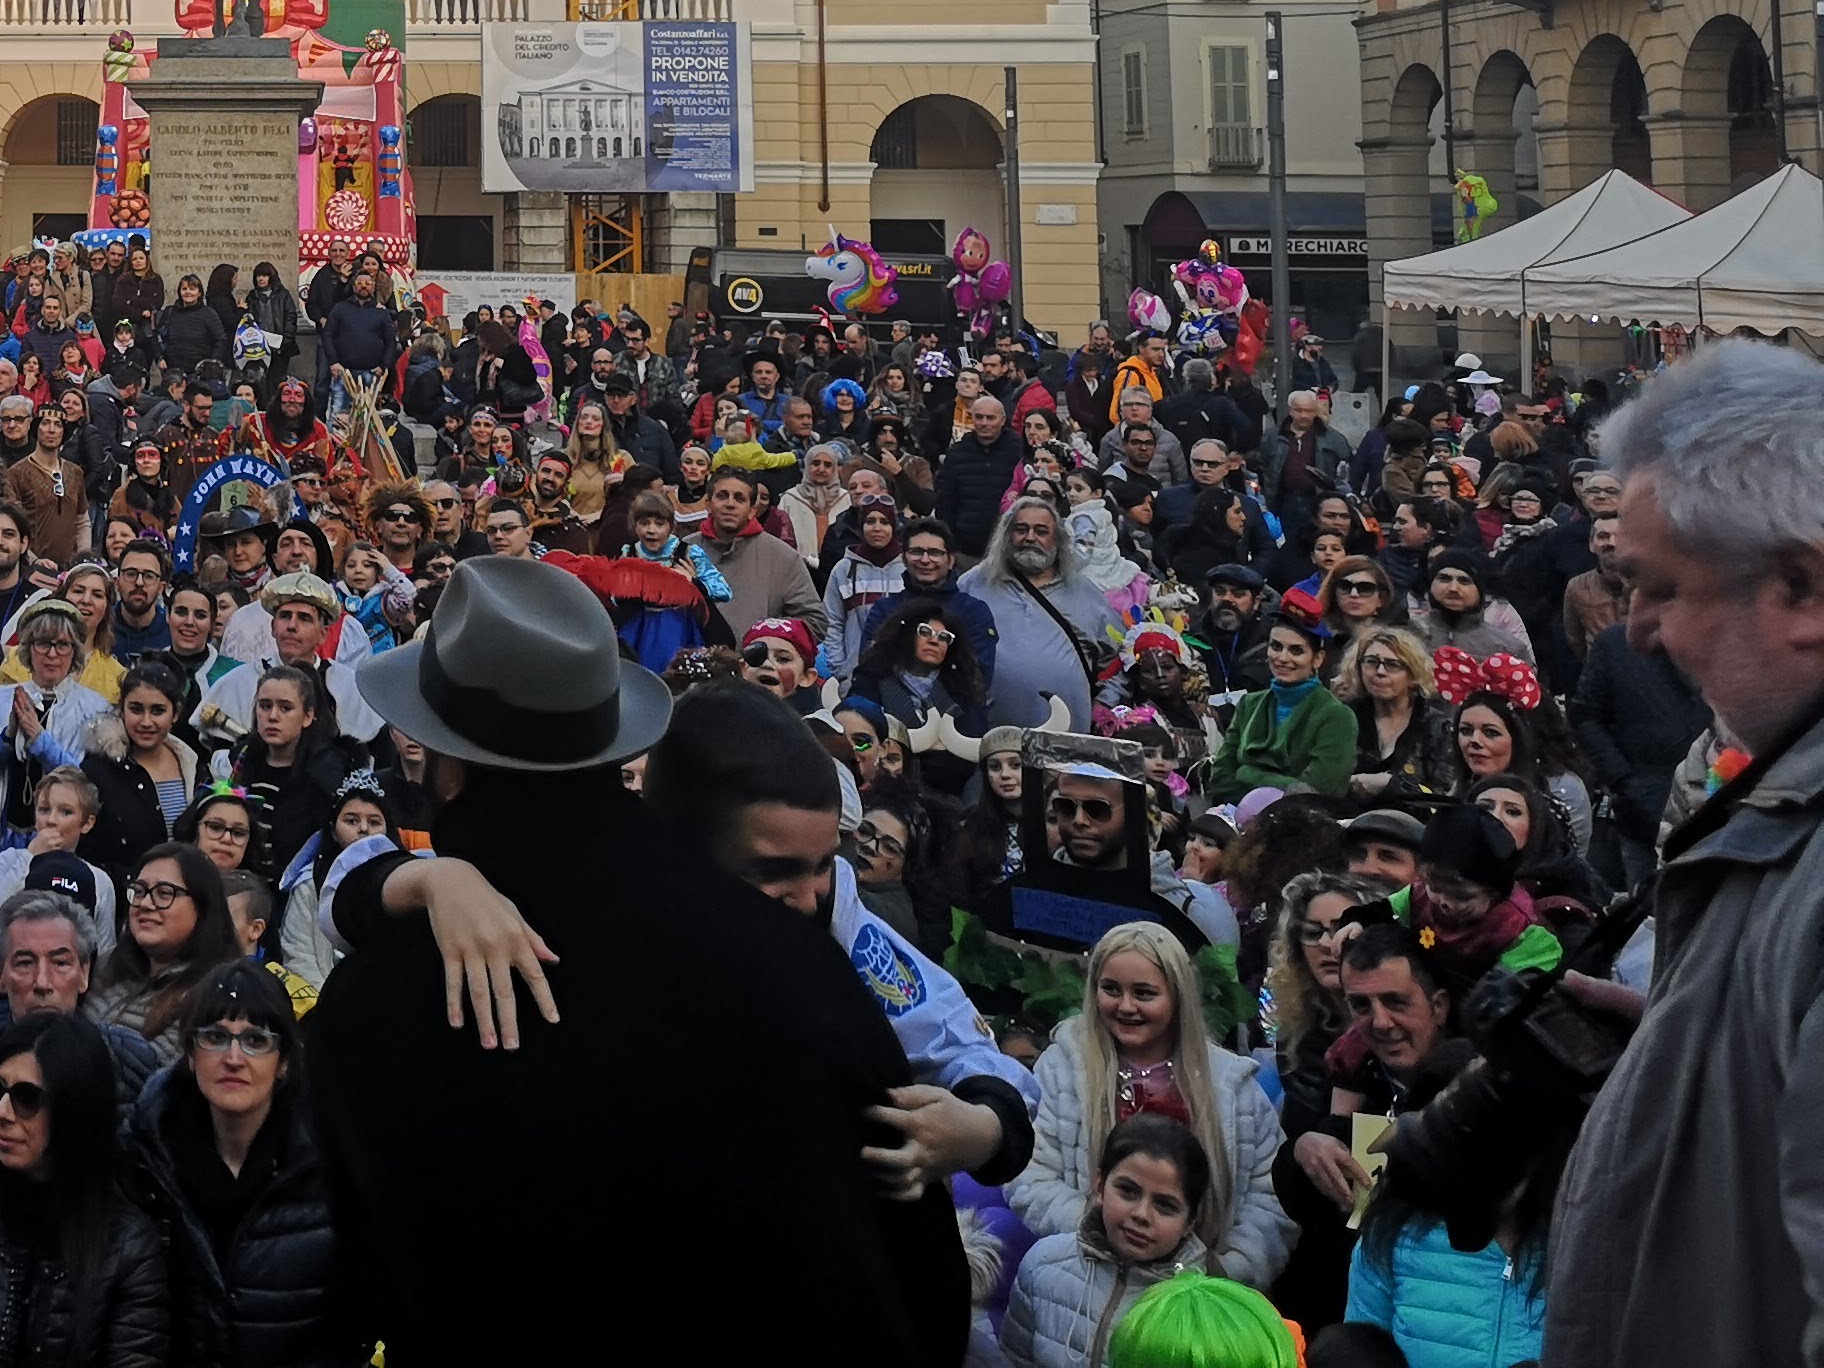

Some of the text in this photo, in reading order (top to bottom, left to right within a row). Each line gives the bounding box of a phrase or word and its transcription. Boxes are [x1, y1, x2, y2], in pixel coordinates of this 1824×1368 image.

[514, 34, 553, 43] PALAZZO
[514, 43, 570, 52] DEL CREDITO
[514, 52, 554, 60] ITALIANO
[651, 56, 730, 70] PROPONE
[651, 70, 730, 83] IN VENDITA
[652, 96, 731, 107] APPARTAMENTI
[673, 107, 731, 117] E BILOCALI
[1256, 239, 1369, 253] MRECHIARO
[733, 287, 757, 303] AV4
[192, 464, 227, 504] JOHN
[51, 876, 79, 893] FILA
